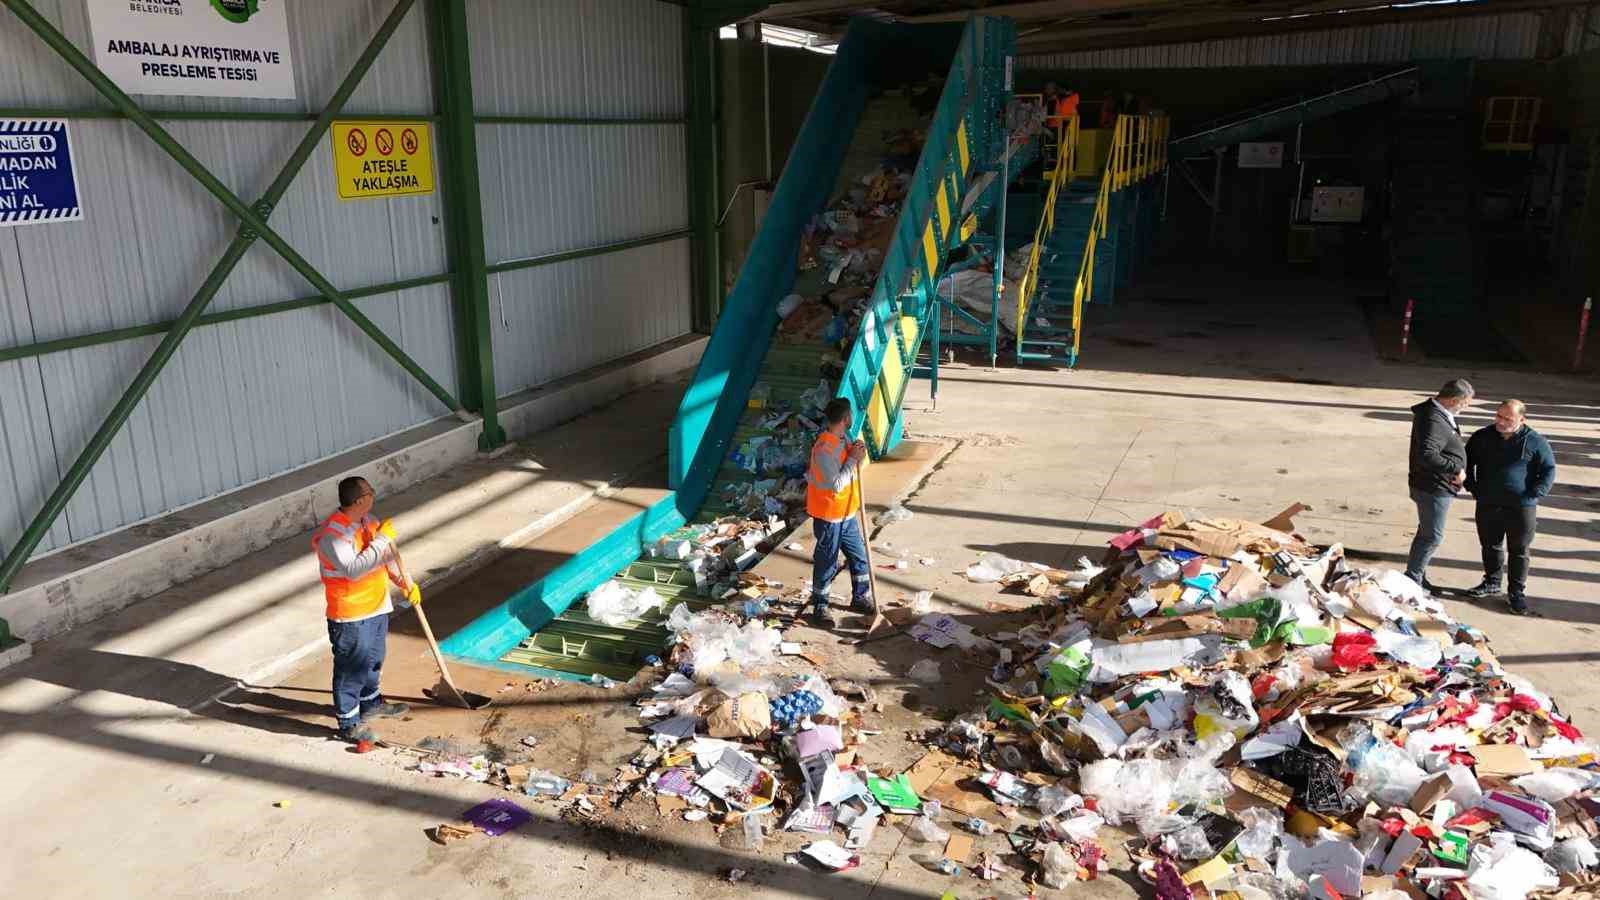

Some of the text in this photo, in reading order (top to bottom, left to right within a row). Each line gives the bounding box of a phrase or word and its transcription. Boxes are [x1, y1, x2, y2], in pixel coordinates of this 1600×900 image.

[129, 3, 183, 16] BELEDİYESİ
[108, 39, 281, 64] AMBALAJ AYRIŞTIRMA VE
[142, 62, 257, 81] PRESLEME TESİSİ
[363, 159, 408, 175] ATEŞLE
[0, 172, 29, 190] LİK
[353, 175, 419, 191] YAKLAŞMA
[22, 194, 44, 208] AL
